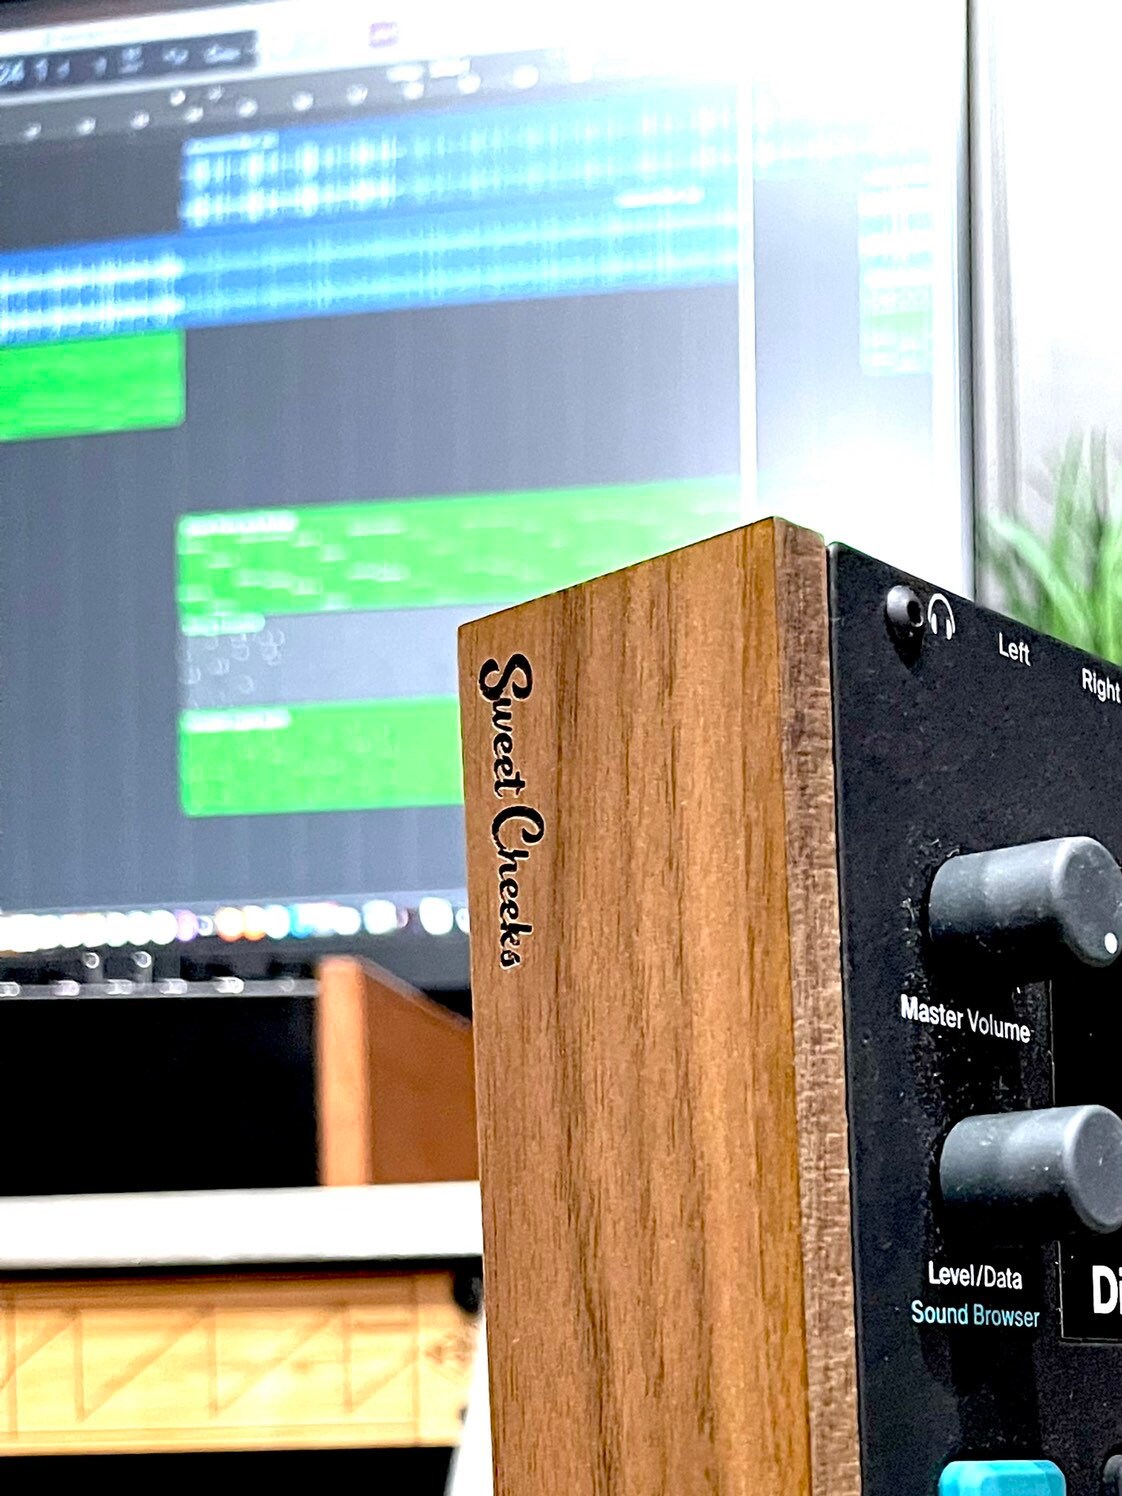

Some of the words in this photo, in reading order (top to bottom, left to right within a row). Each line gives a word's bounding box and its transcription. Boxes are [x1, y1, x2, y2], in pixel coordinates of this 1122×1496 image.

[998, 632, 1031, 666] Left
[1081, 667, 1122, 704] Right
[478, 653, 533, 798] Sweet
[491, 805, 547, 971] Cheeks
[900, 994, 963, 1029] Master
[967, 1008, 1031, 1043] Volume
[928, 1261, 1023, 1290] Level/Data
[911, 1299, 968, 1325] Sound
[973, 1302, 1041, 1328] Browser
